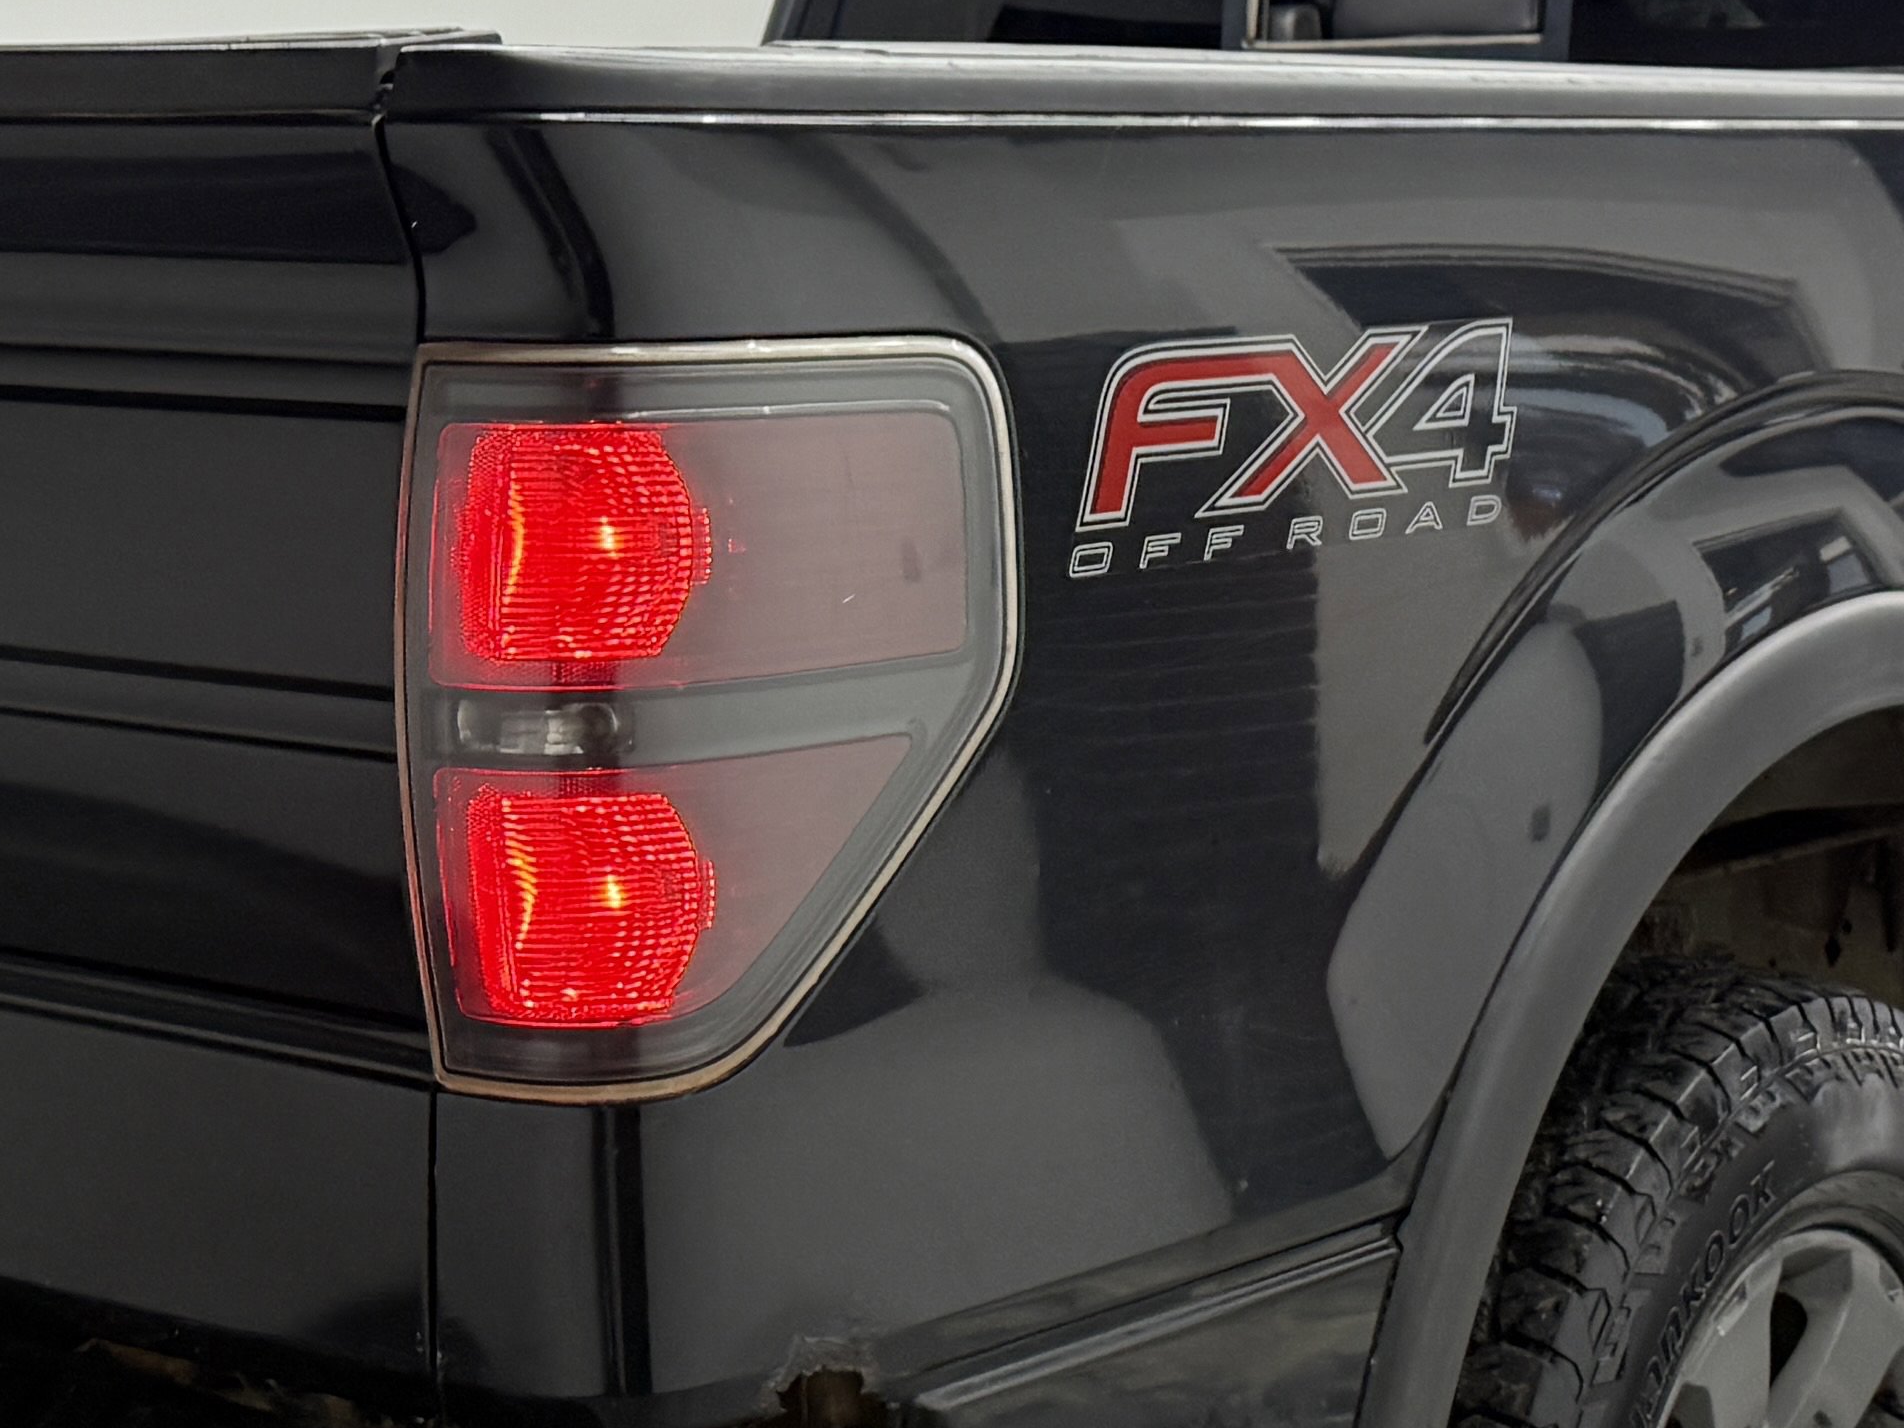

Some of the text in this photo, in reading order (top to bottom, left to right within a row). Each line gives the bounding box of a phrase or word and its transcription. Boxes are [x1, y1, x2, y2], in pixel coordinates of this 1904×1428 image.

[1076, 317, 1517, 531] FX4
[1070, 496, 1502, 578] OFF ROAD
